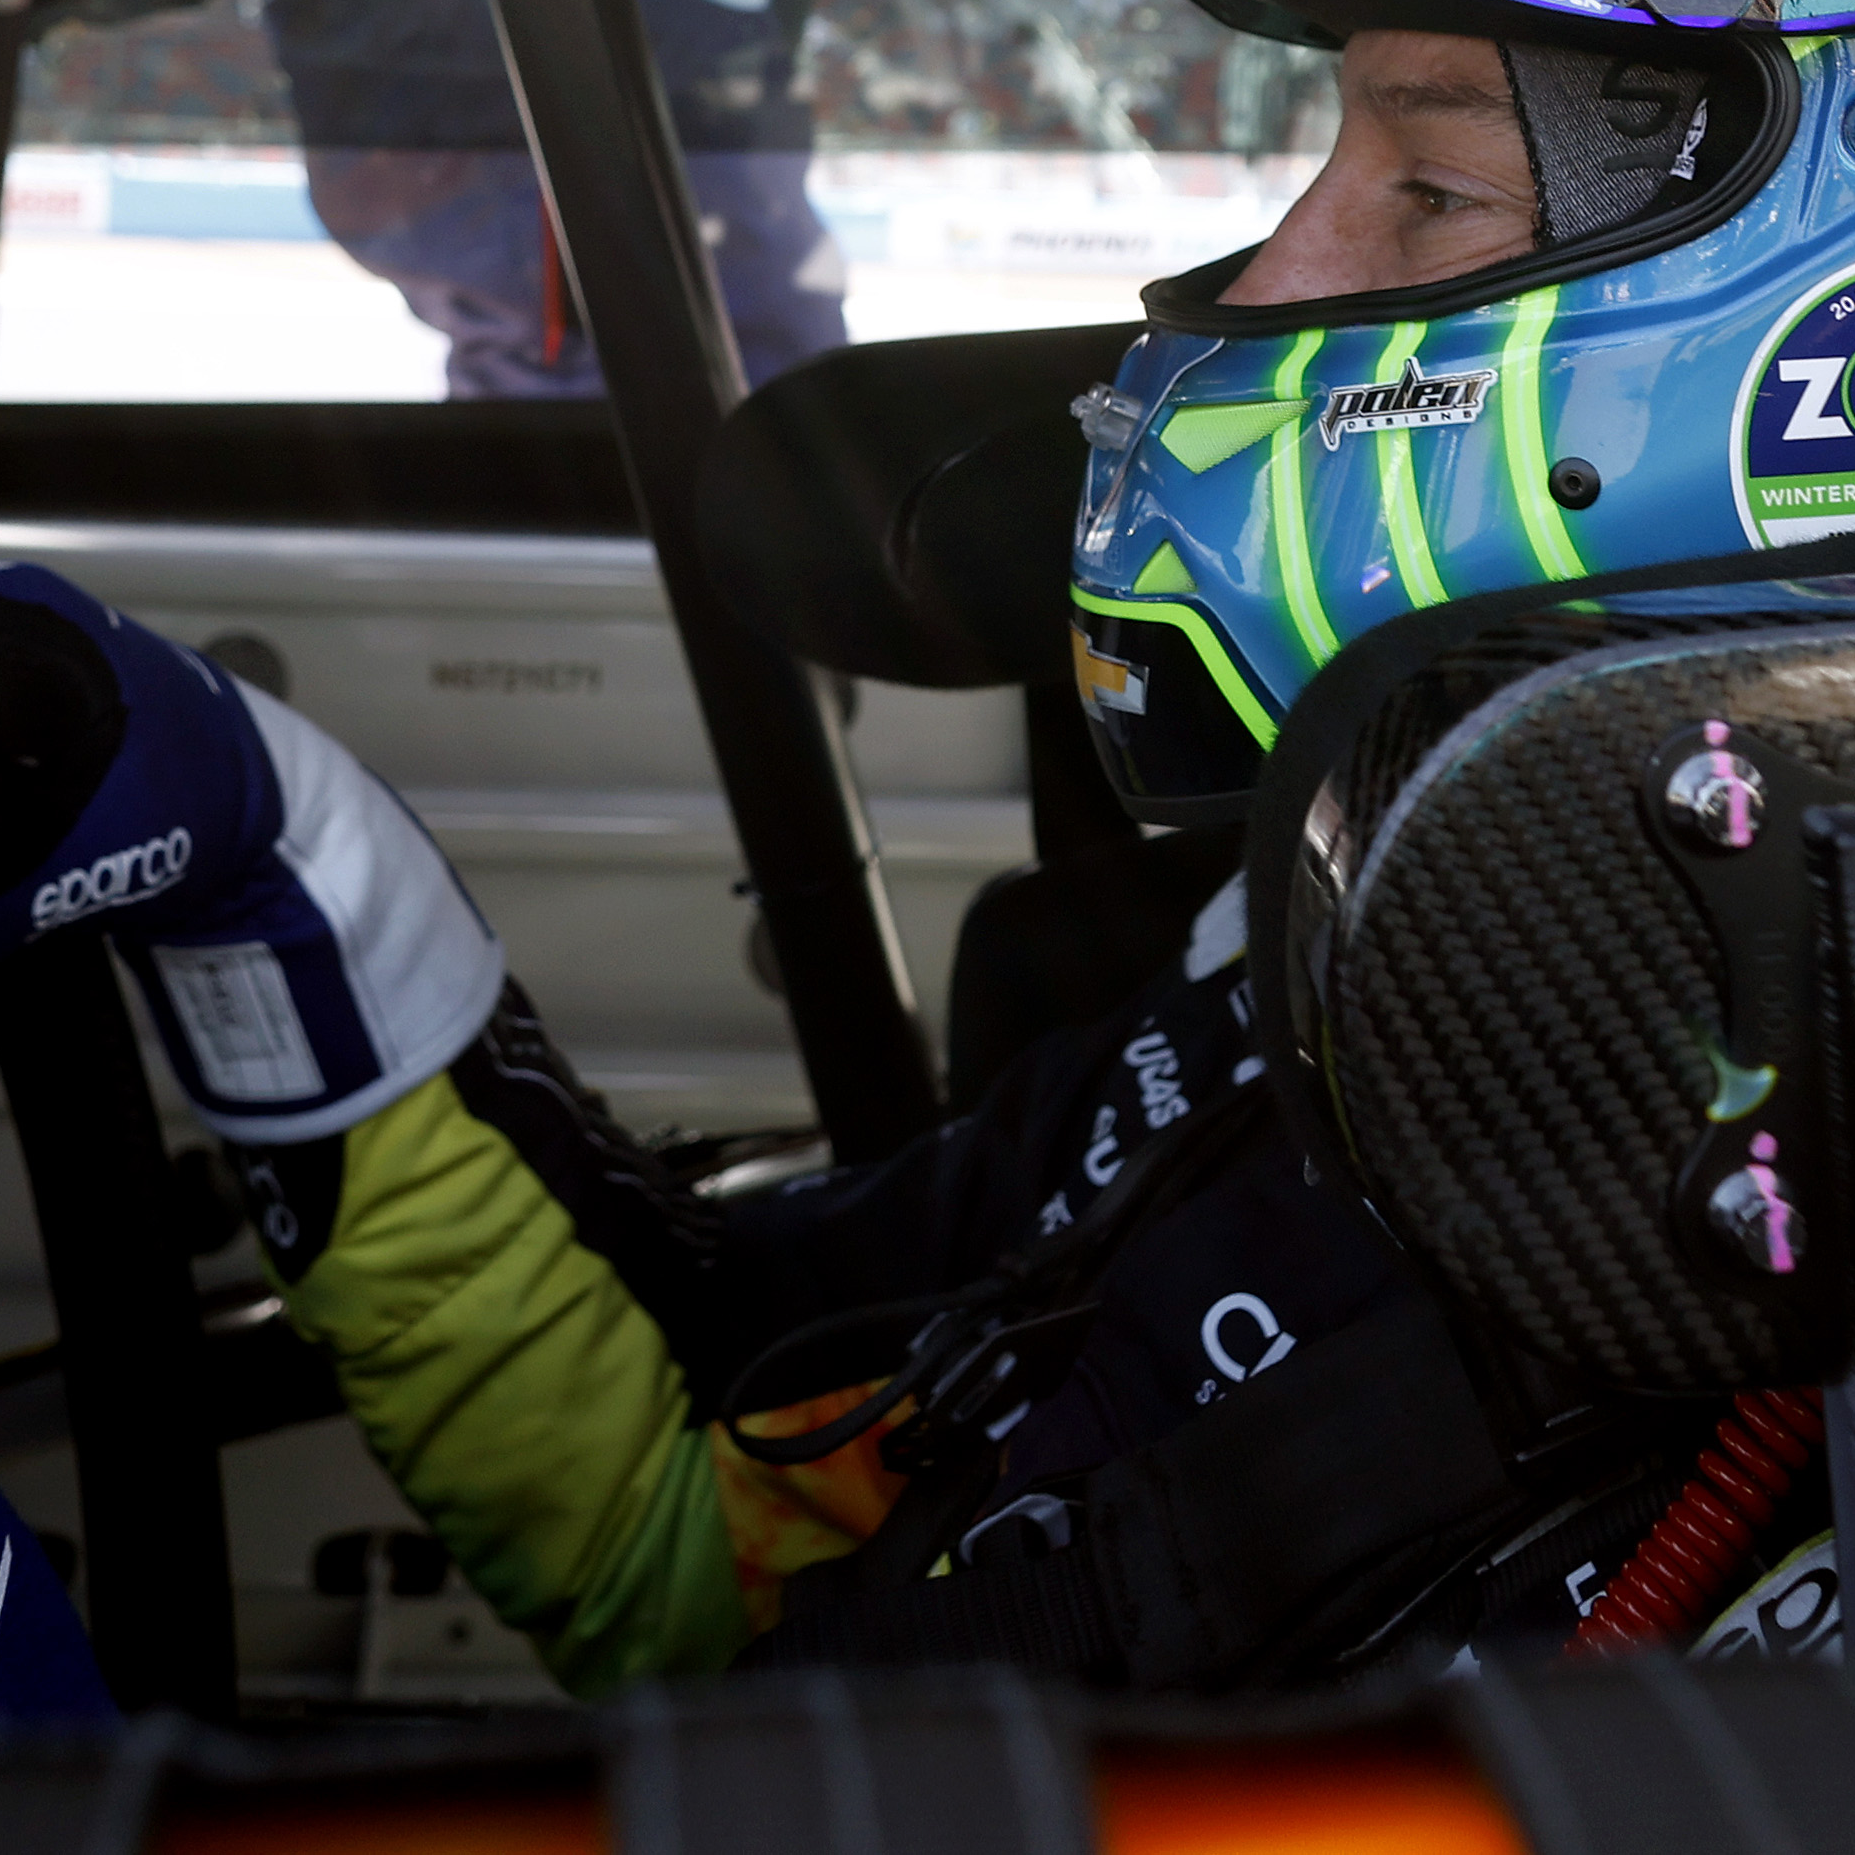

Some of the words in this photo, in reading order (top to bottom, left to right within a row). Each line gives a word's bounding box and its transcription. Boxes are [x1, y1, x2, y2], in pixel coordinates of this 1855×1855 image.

[1828, 295, 1855, 321] 20
[1346, 410, 1474, 430] DESIGNS
[31, 826, 193, 930] sparco
